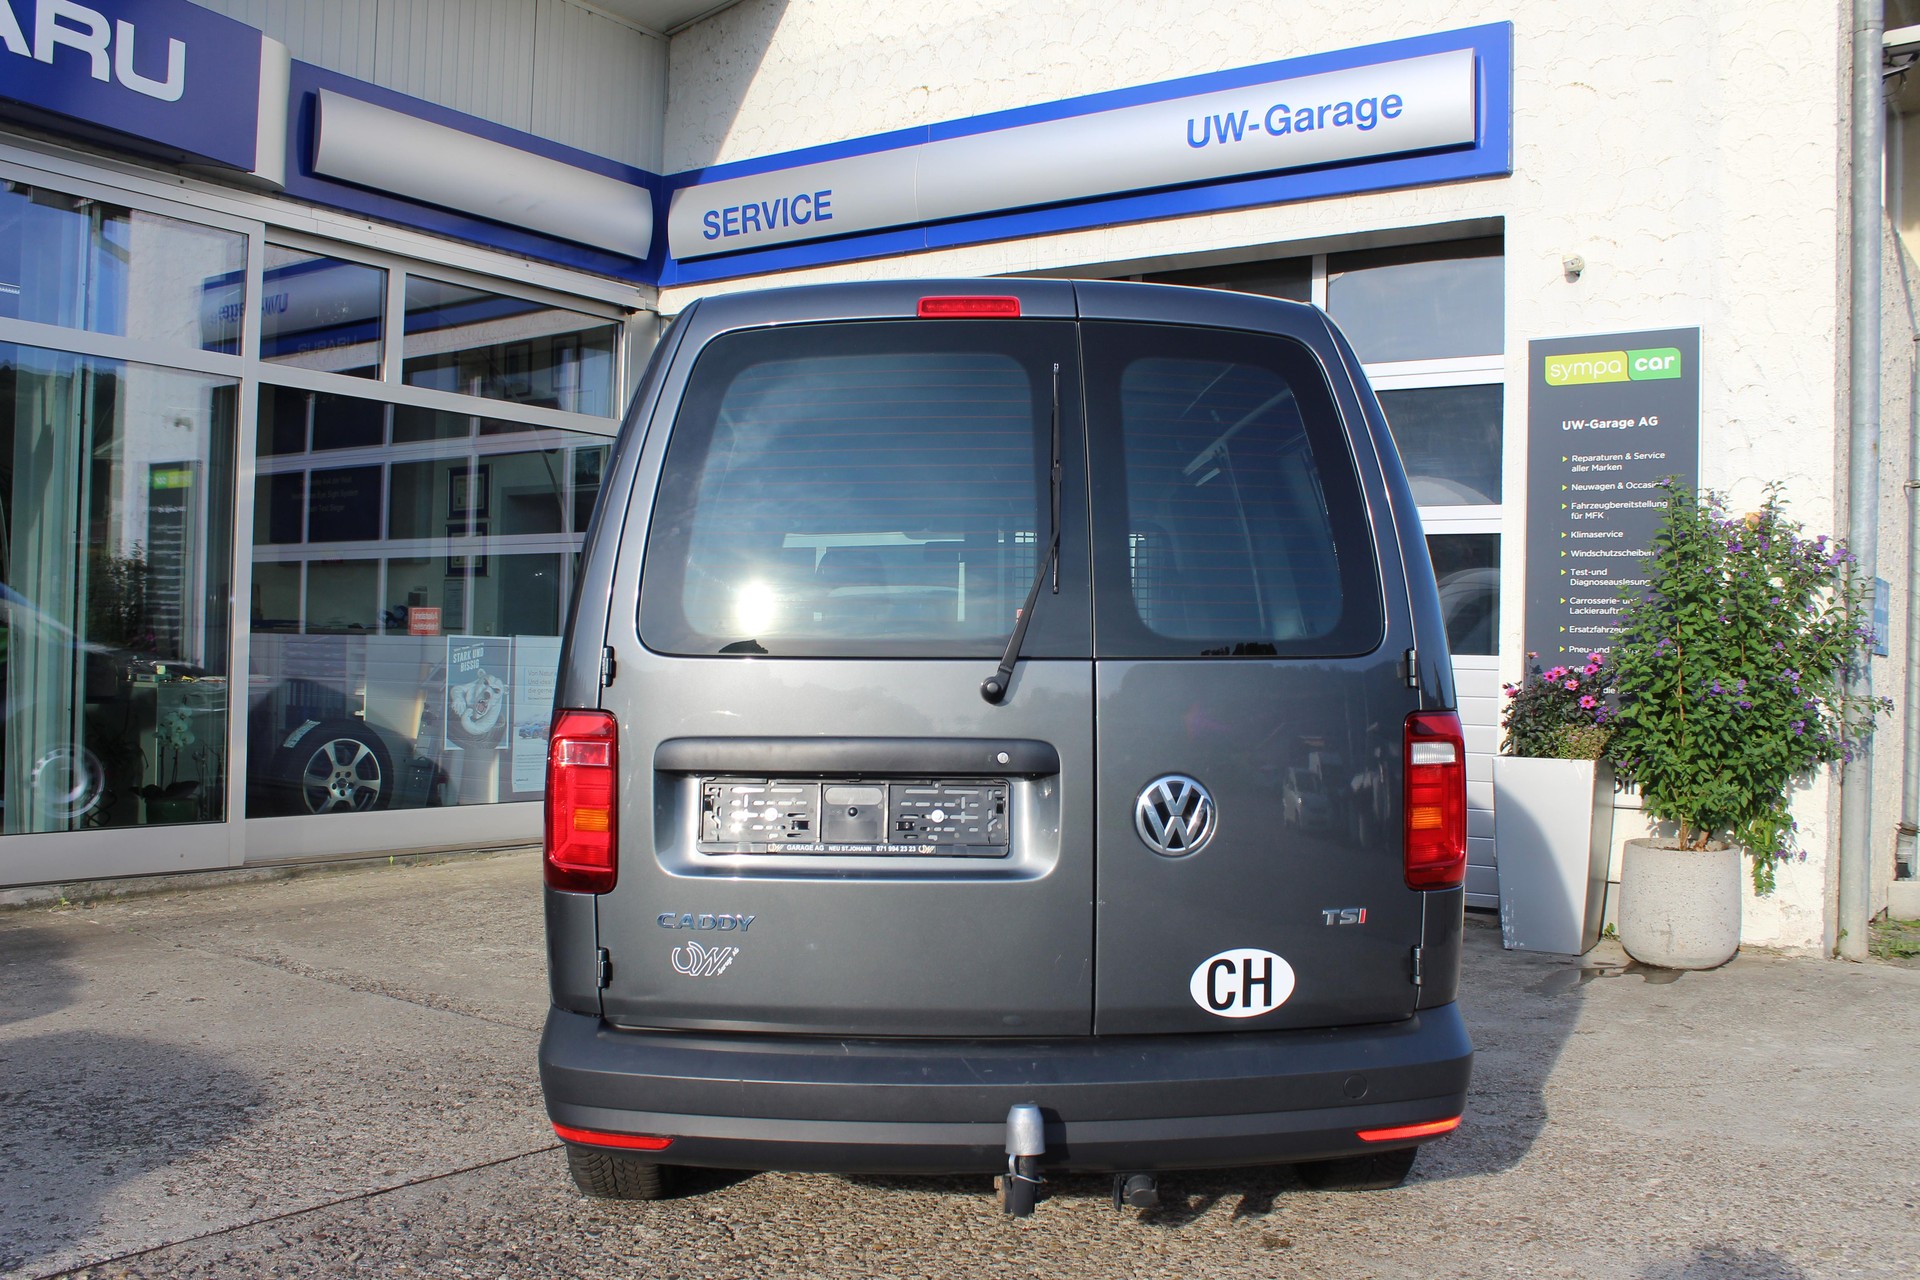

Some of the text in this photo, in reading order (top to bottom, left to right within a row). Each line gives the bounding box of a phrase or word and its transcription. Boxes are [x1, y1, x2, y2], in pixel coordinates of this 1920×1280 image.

[1187, 91, 1404, 150] UW-Garage
[702, 189, 833, 241] SERVICE
[1550, 355, 1676, 381] sympa car
[1562, 415, 1659, 431] UW-Garage AG
[1571, 453, 1623, 463] Reparaturen
[1633, 452, 1666, 460] Service
[1571, 463, 1623, 472] aller Marken
[1571, 483, 1616, 492] Neuwagen
[1617, 481, 1624, 490] &
[1571, 500, 1668, 510] Fahrzeugbereitstellung
[1571, 512, 1604, 520] für MFK
[1570, 530, 1624, 539] Klimaservice
[1569, 597, 1620, 605] Carrosserie-
[1568, 645, 1592, 653] Pneu-
[1593, 646, 1610, 654] und
[453, 650, 471, 664] STARK
[656, 912, 756, 932] CADDY
[1322, 908, 1366, 925] TSI
[1206, 957, 1273, 1011] CH
